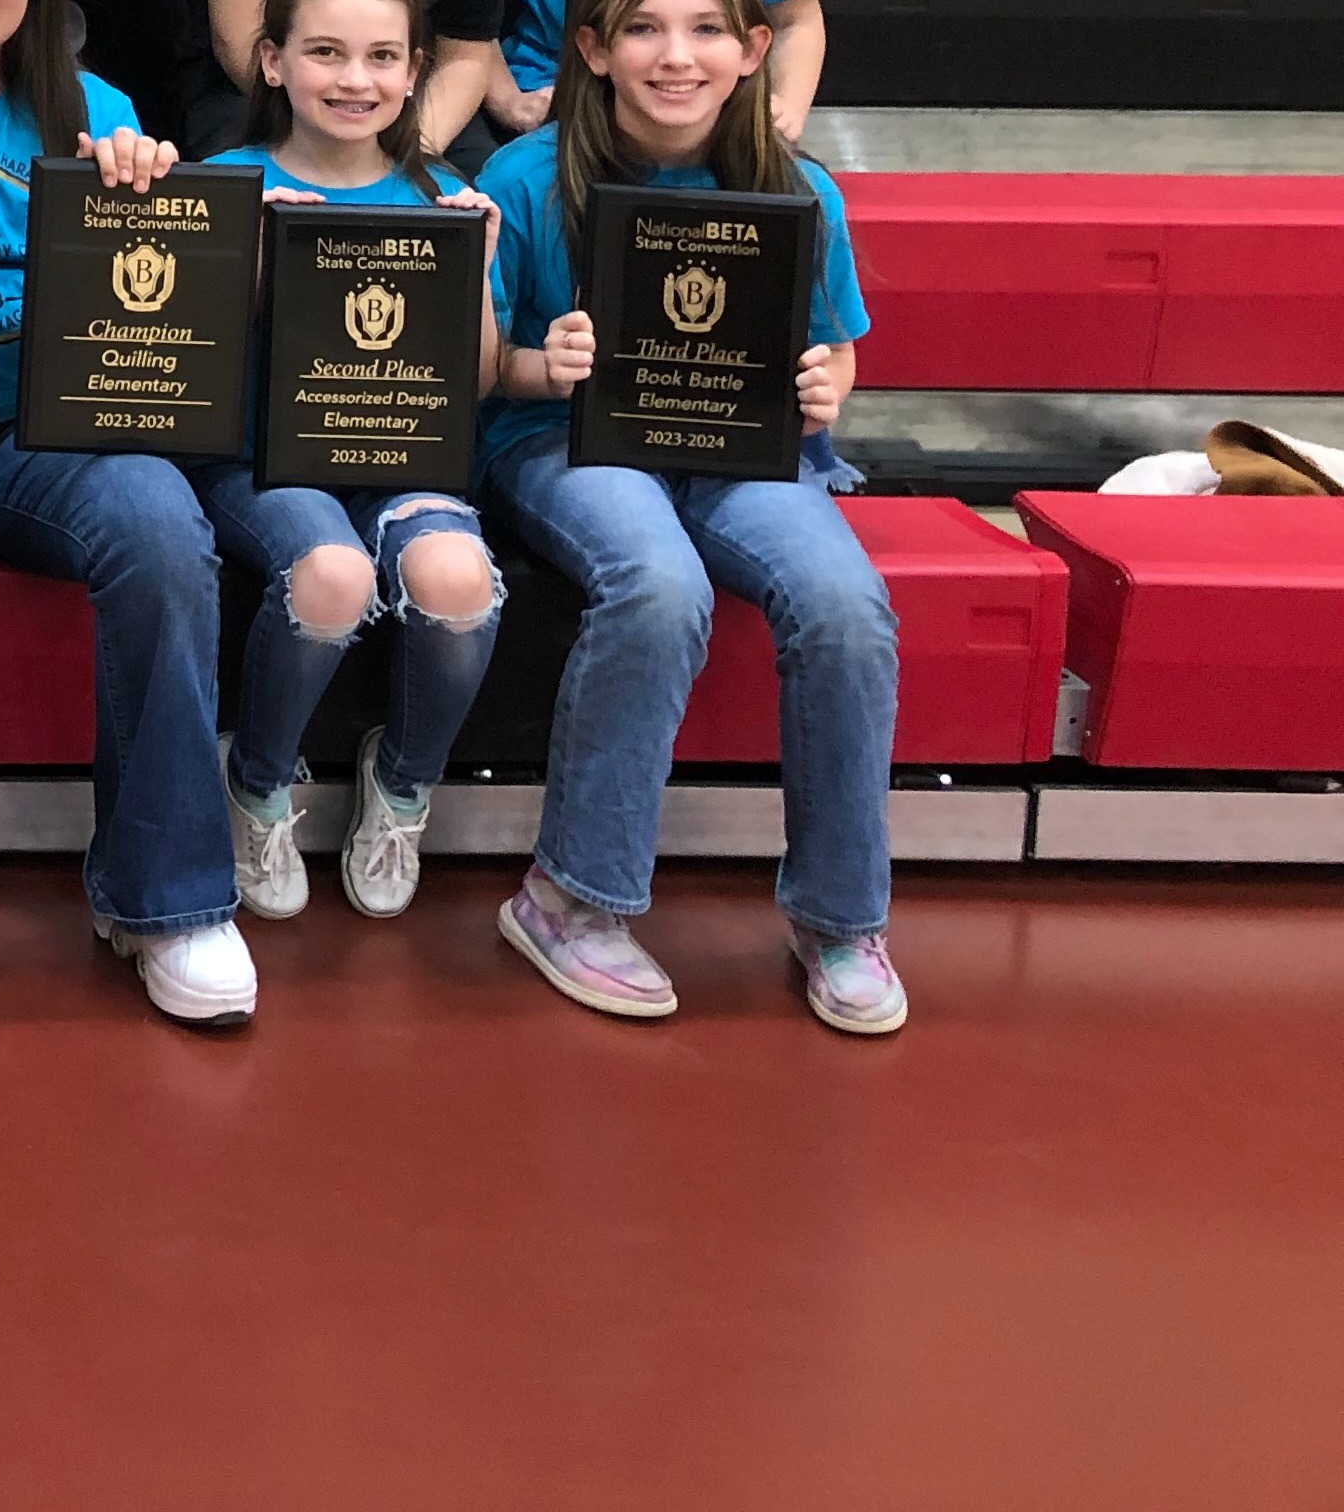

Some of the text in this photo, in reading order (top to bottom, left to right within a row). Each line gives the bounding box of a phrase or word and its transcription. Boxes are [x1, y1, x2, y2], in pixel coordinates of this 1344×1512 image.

[84, 195, 208, 217] NationalBETA
[84, 215, 210, 232] State Convention
[636, 217, 758, 242] NationalBETA
[317, 237, 435, 258] NationalBETA
[635, 237, 760, 256] State Convention
[316, 257, 436, 272] State Convention
[87, 320, 192, 345] Champion
[636, 338, 747, 363] Third Place
[101, 350, 177, 373] Quilling
[311, 358, 434, 379] Second Place
[87, 375, 187, 397] Elementary
[635, 368, 744, 391] Book Battle
[295, 390, 448, 409] Accessorized Design
[638, 393, 737, 417] Elementary
[94, 413, 174, 429] 2023-2024
[323, 413, 419, 433] Elementary
[645, 430, 725, 449] 2023-2024
[330, 449, 408, 465] 2023-2024
